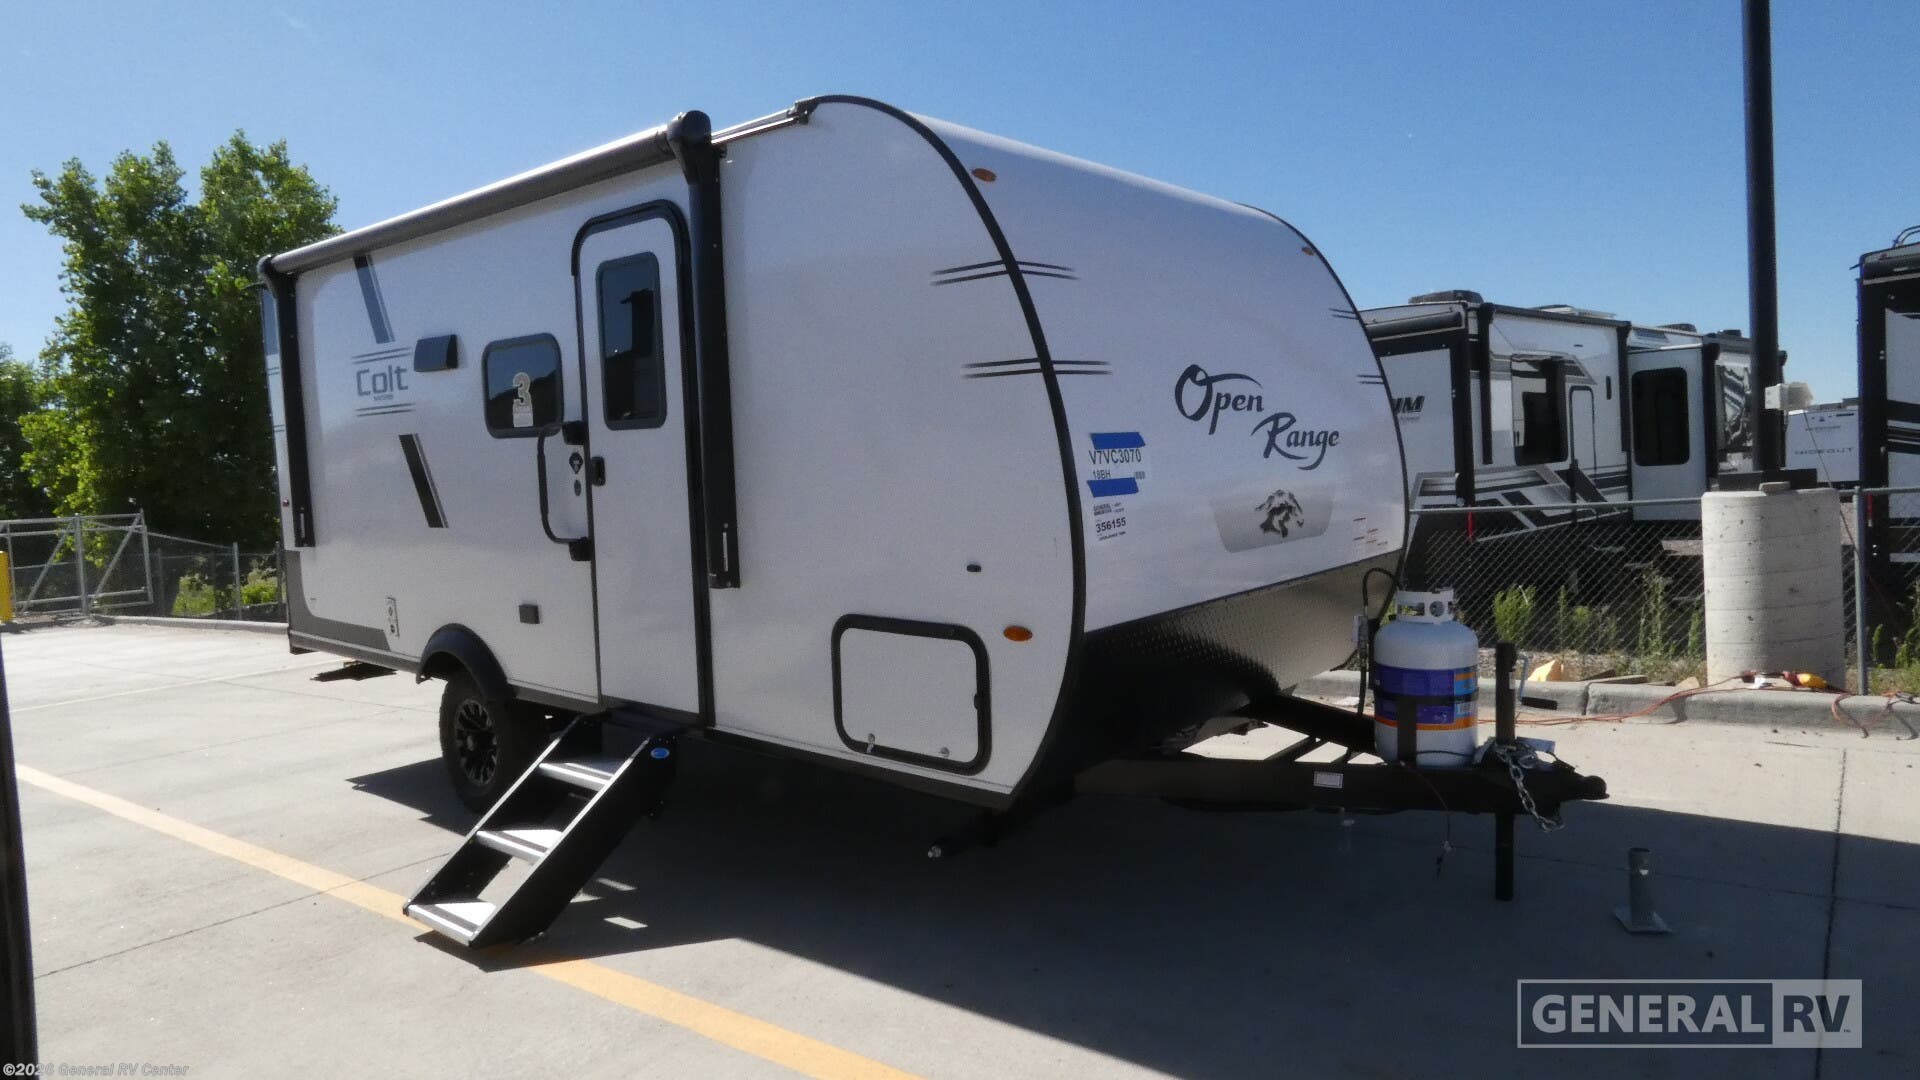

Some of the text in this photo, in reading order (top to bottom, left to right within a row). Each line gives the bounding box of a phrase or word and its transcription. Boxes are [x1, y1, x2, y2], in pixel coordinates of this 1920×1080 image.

[356, 365, 409, 396] Colt
[512, 371, 532, 414] 3
[1175, 364, 1264, 435] Open
[1088, 448, 1142, 465] V7VC3070
[1251, 412, 1340, 470] Range
[1095, 517, 1127, 533] 356155
